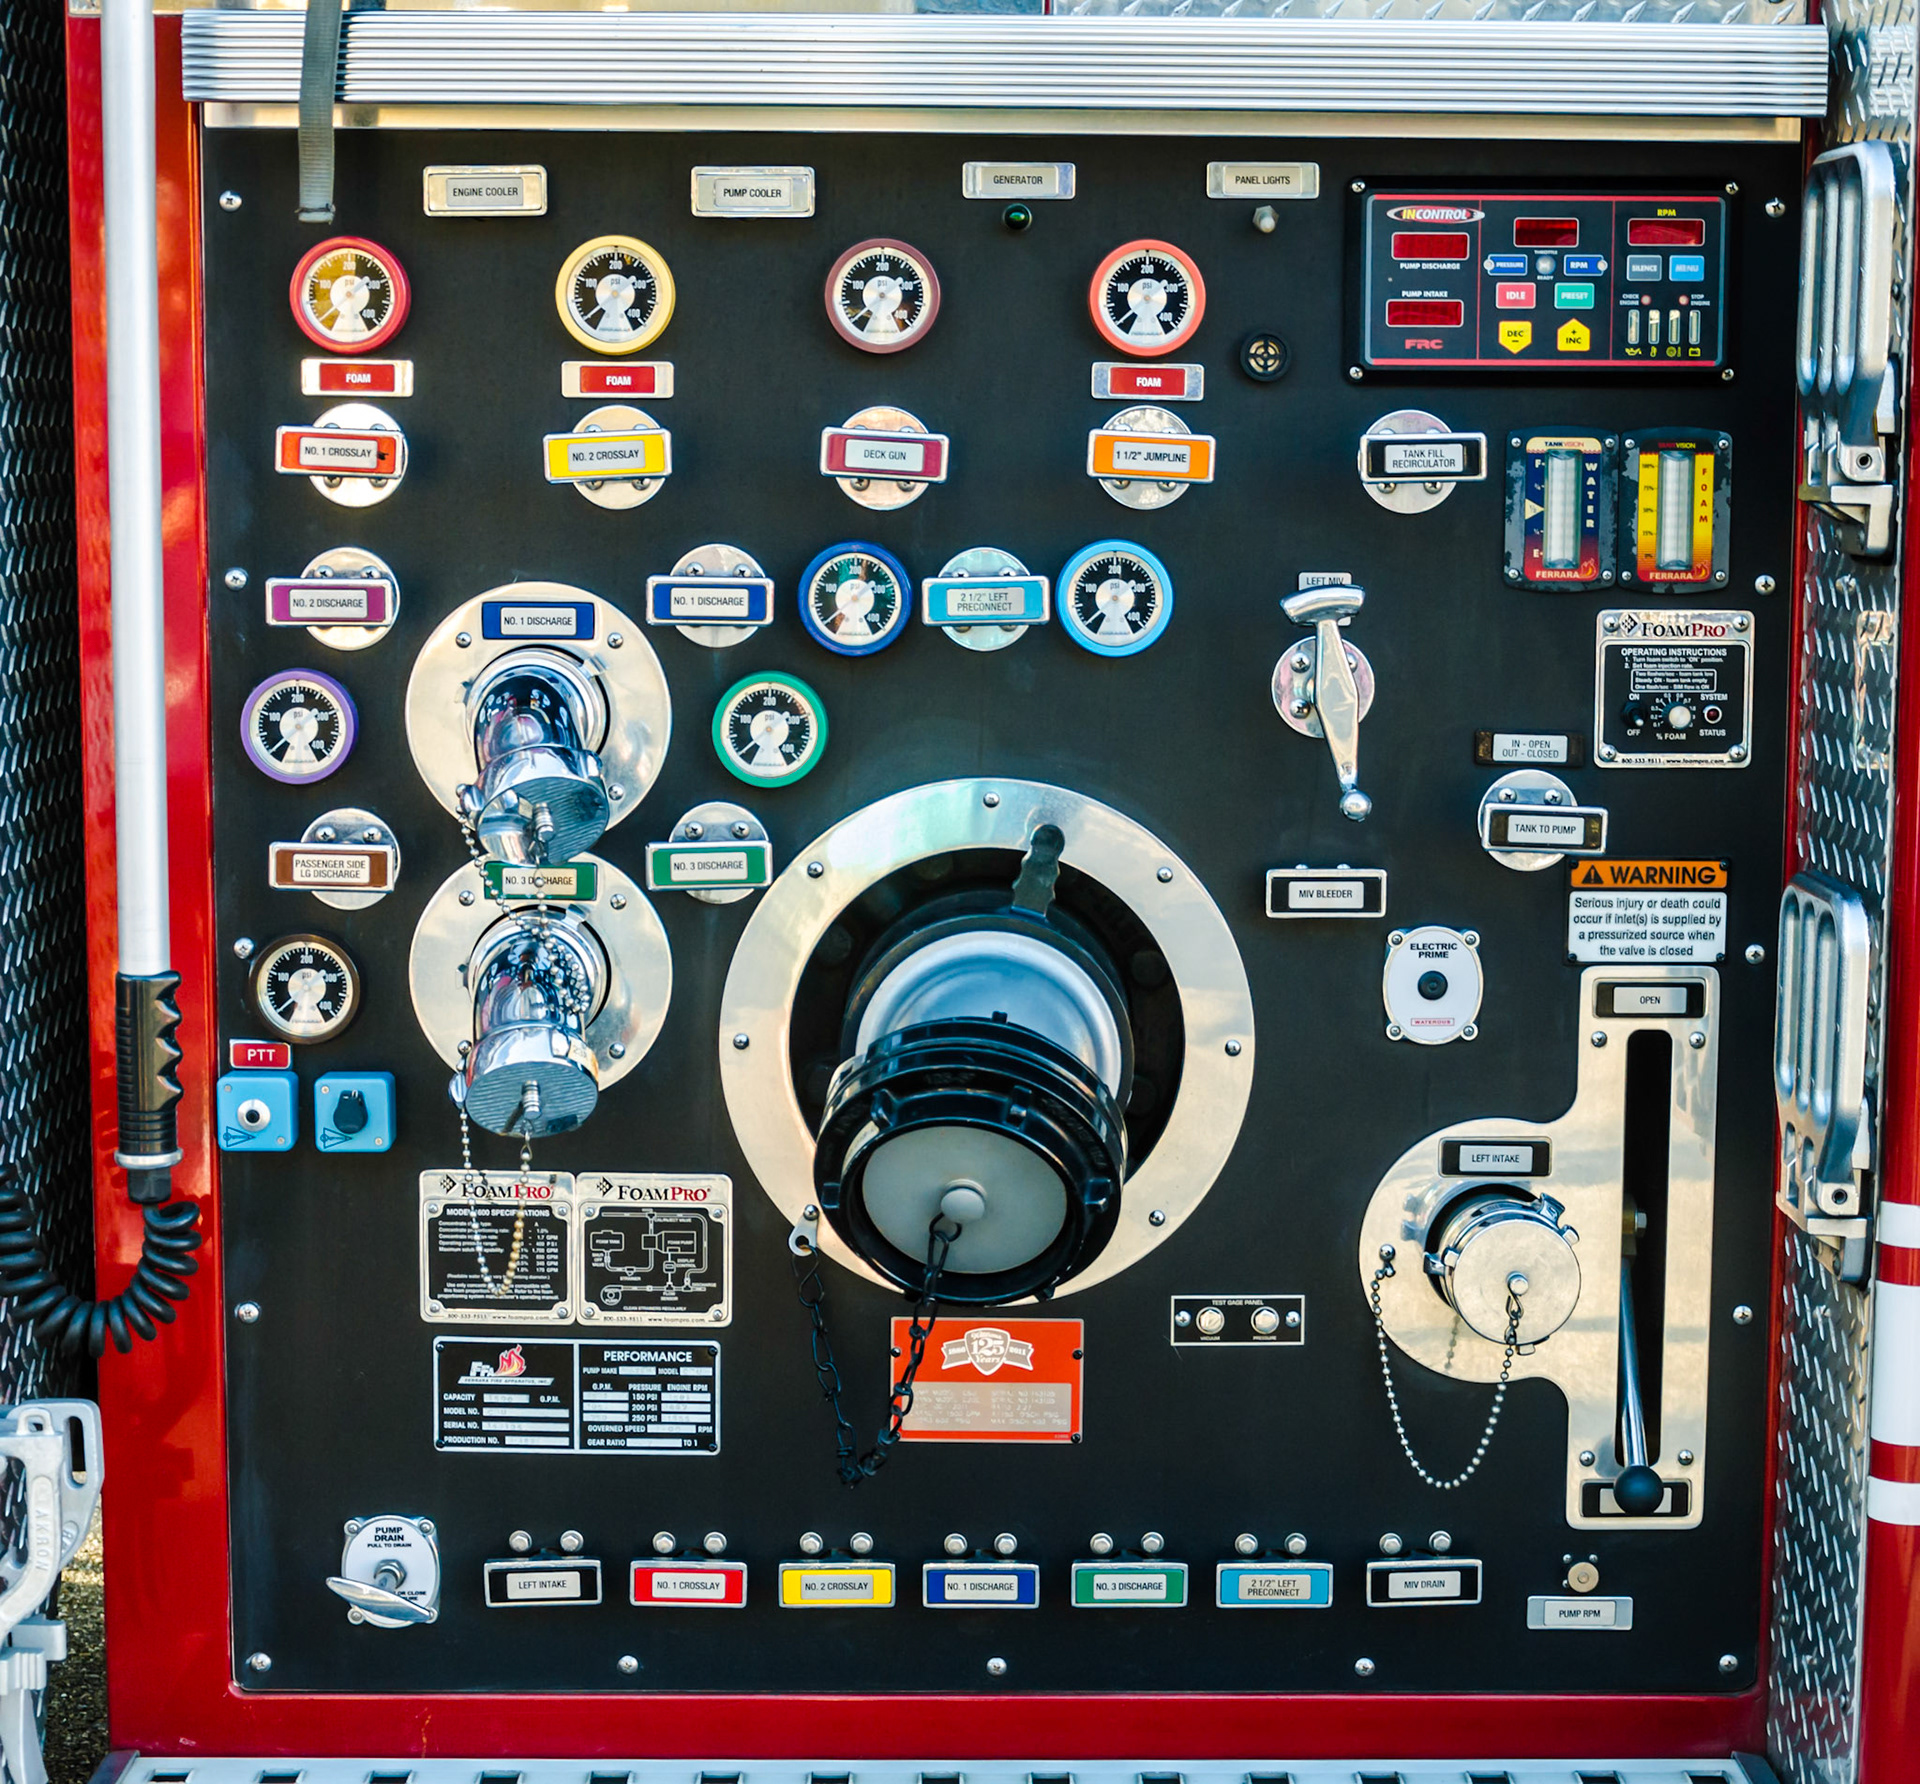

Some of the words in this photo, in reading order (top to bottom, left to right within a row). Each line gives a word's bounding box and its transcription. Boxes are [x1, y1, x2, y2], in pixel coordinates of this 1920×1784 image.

[993, 175, 1043, 185] GENERATOR
[1235, 175, 1261, 184] PANEL
[1262, 176, 1291, 185] LIGHTS
[453, 187, 483, 197] ENGINE
[485, 187, 518, 196] COOLER
[723, 188, 748, 197] PUMP
[749, 188, 782, 198] COOLER
[1402, 208, 1467, 220] INCONTROL
[609, 260, 622, 270] 200
[1140, 264, 1154, 274] 200
[1570, 261, 1588, 269] RPM
[1632, 264, 1657, 272] SILENCE
[1117, 283, 1129, 292] 100
[1142, 282, 1153, 290] psi
[1506, 291, 1526, 300] IDLE
[1561, 292, 1588, 300] PRESET
[1160, 312, 1173, 322] 400
[1565, 337, 1582, 345] INC
[346, 373, 371, 383] FOAM
[606, 375, 631, 386] FOAM
[1136, 377, 1162, 387] FOAM
[305, 446, 320, 455] NO.
[322, 447, 325, 455] 1
[328, 447, 372, 457] CROSSLAY
[572, 452, 586, 461] NO.
[589, 452, 594, 461] 2
[596, 449, 639, 460] CROSSLAY
[864, 449, 886, 459] DECK
[888, 451, 906, 460] GUN
[1403, 449, 1426, 458] TANK
[1428, 449, 1445, 458] FILL
[1116, 451, 1120, 459] 1
[1143, 451, 1188, 463] JUMPLINE
[1392, 458, 1456, 469] RECIRCULATOR
[1585, 462, 1598, 529] WATER
[1699, 468, 1709, 524] FOAM
[1535, 570, 1580, 579] FERRARA
[673, 597, 689, 606] NO.
[691, 597, 694, 605] 1
[697, 596, 744, 606] DISCHARGE
[961, 593, 966, 602] 2
[988, 593, 1008, 602] LEFT
[293, 598, 307, 607] NO.
[309, 598, 315, 608] 2
[316, 598, 363, 608] DISCHARGE
[957, 603, 1012, 611] PRECONNECT
[504, 616, 519, 625] NO.
[520, 617, 524, 625] 1
[527, 616, 572, 626] DISCHARGE
[1621, 649, 1667, 657] OPERATING
[1669, 649, 1727, 657] INSTRUCTIONS
[1511, 740, 1520, 748] IN
[1528, 740, 1551, 749] OPEN
[1502, 749, 1518, 757] OUT
[1527, 750, 1559, 759] CLOSED
[1515, 824, 1537, 833] TANK
[1539, 824, 1550, 833] TO
[1552, 825, 1576, 834] PUMP
[295, 860, 344, 868] PASSENGER
[346, 861, 366, 869] SIDE
[673, 862, 687, 871] NO.
[690, 862, 695, 870] 3
[697, 860, 743, 870] DISCHARGE
[300, 870, 311, 878] LG
[313, 870, 360, 879] DISCHARGE
[1610, 866, 1716, 885] WARNING
[505, 876, 519, 885] NO.
[521, 876, 526, 885] 3
[528, 876, 573, 885] DCHARGE
[1299, 890, 1314, 898] MIV
[1316, 889, 1353, 898] BLEEDER
[1574, 897, 1613, 908] Serious
[1616, 898, 1644, 911] injury
[1647, 900, 1658, 908] or
[1660, 898, 1689, 909] death
[1692, 898, 1721, 909] could
[1573, 915, 1603, 924] occur
[1605, 913, 1612, 924] if
[1614, 913, 1648, 926] inlet(s)
[1651, 914, 1659, 924] is
[1662, 914, 1706, 927] supplied
[1709, 914, 1722, 927] by
[1578, 931, 1585, 940] a
[1588, 929, 1647, 942] pressurized
[1650, 931, 1685, 940] source
[1687, 930, 1715, 941] when
[1410, 943, 1458, 951] ELECTRIC
[1599, 945, 1616, 955] the
[1618, 945, 1645, 956] valve
[1648, 945, 1657, 956] is
[1659, 945, 1693, 956] closed
[1418, 951, 1449, 959] PRIME
[1640, 996, 1661, 1004] OPEN
[247, 1049, 276, 1061] PTT
[1472, 1154, 1490, 1163] LEFT
[1492, 1154, 1520, 1163] INTAKE
[971, 1338, 1004, 1355] 125
[604, 1351, 692, 1362] PERFORMANCE
[443, 1393, 475, 1401] CAPACITY
[632, 1393, 645, 1401] 150
[646, 1393, 658, 1401] PSI
[35, 1509, 50, 1571] AKRON
[374, 1534, 404, 1542] DRAIN
[518, 1581, 537, 1589] LEFT
[539, 1580, 567, 1588] INTAKE
[657, 1581, 670, 1590] NO.
[679, 1581, 720, 1590] CROSSLAY
[805, 1583, 818, 1591] NO.
[820, 1583, 826, 1591] 2
[827, 1582, 868, 1590] CROSSLAY
[947, 1582, 961, 1591] NO.
[970, 1582, 1014, 1591] DISCHARGE
[1095, 1582, 1109, 1591] NO.
[1111, 1582, 1117, 1591] 3
[1118, 1582, 1163, 1591] DISCHARGE
[1251, 1580, 1257, 1588] 2
[1277, 1579, 1297, 1588] LEFT
[1404, 1581, 1419, 1589] MIV
[1421, 1580, 1445, 1588] DRAIN
[1247, 1588, 1300, 1596] PRECONNECT
[1559, 1609, 1581, 1618] PUMP
[1583, 1609, 1601, 1618] RPM
